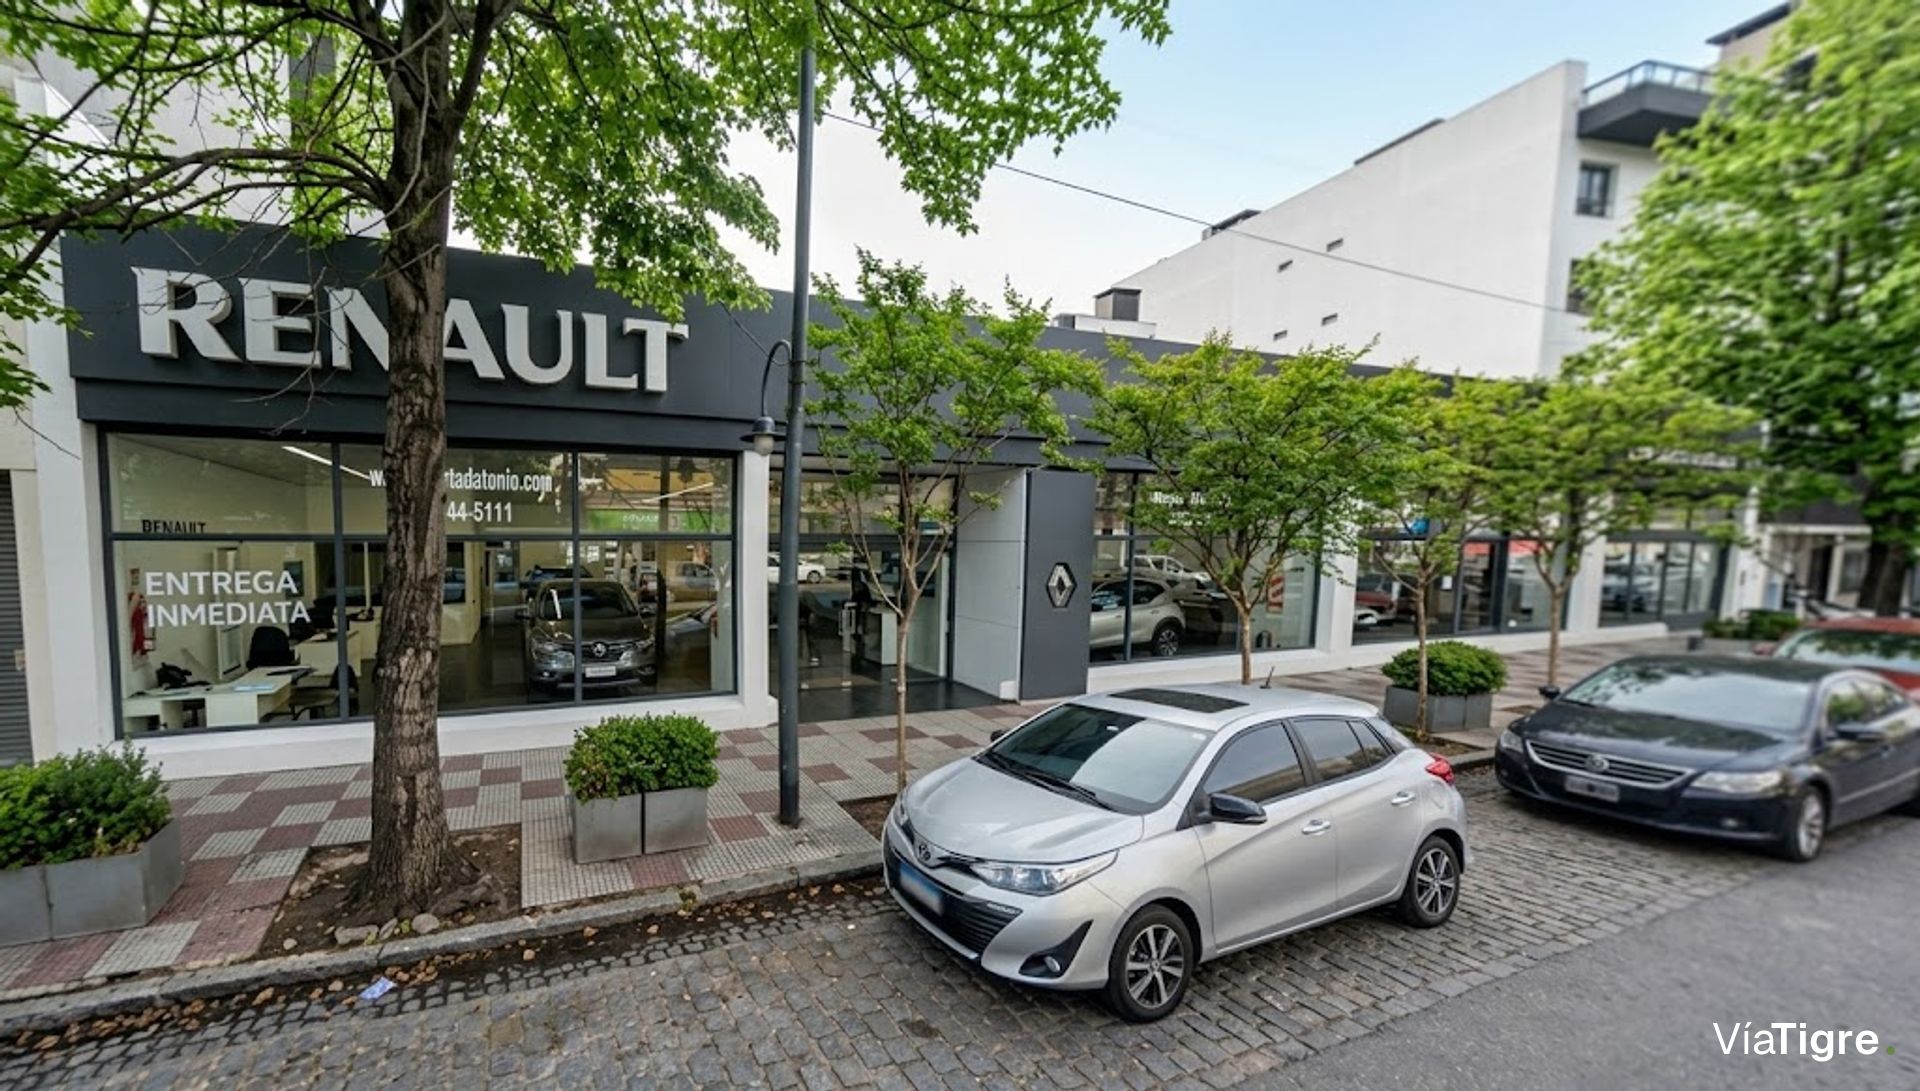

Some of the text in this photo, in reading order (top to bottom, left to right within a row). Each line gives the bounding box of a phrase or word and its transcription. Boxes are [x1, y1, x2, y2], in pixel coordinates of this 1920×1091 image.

[130, 266, 689, 392] RENAULT
[446, 501, 512, 523] 44-5111
[145, 570, 298, 597] ENTREGA
[147, 600, 312, 629] INMEDIATA
